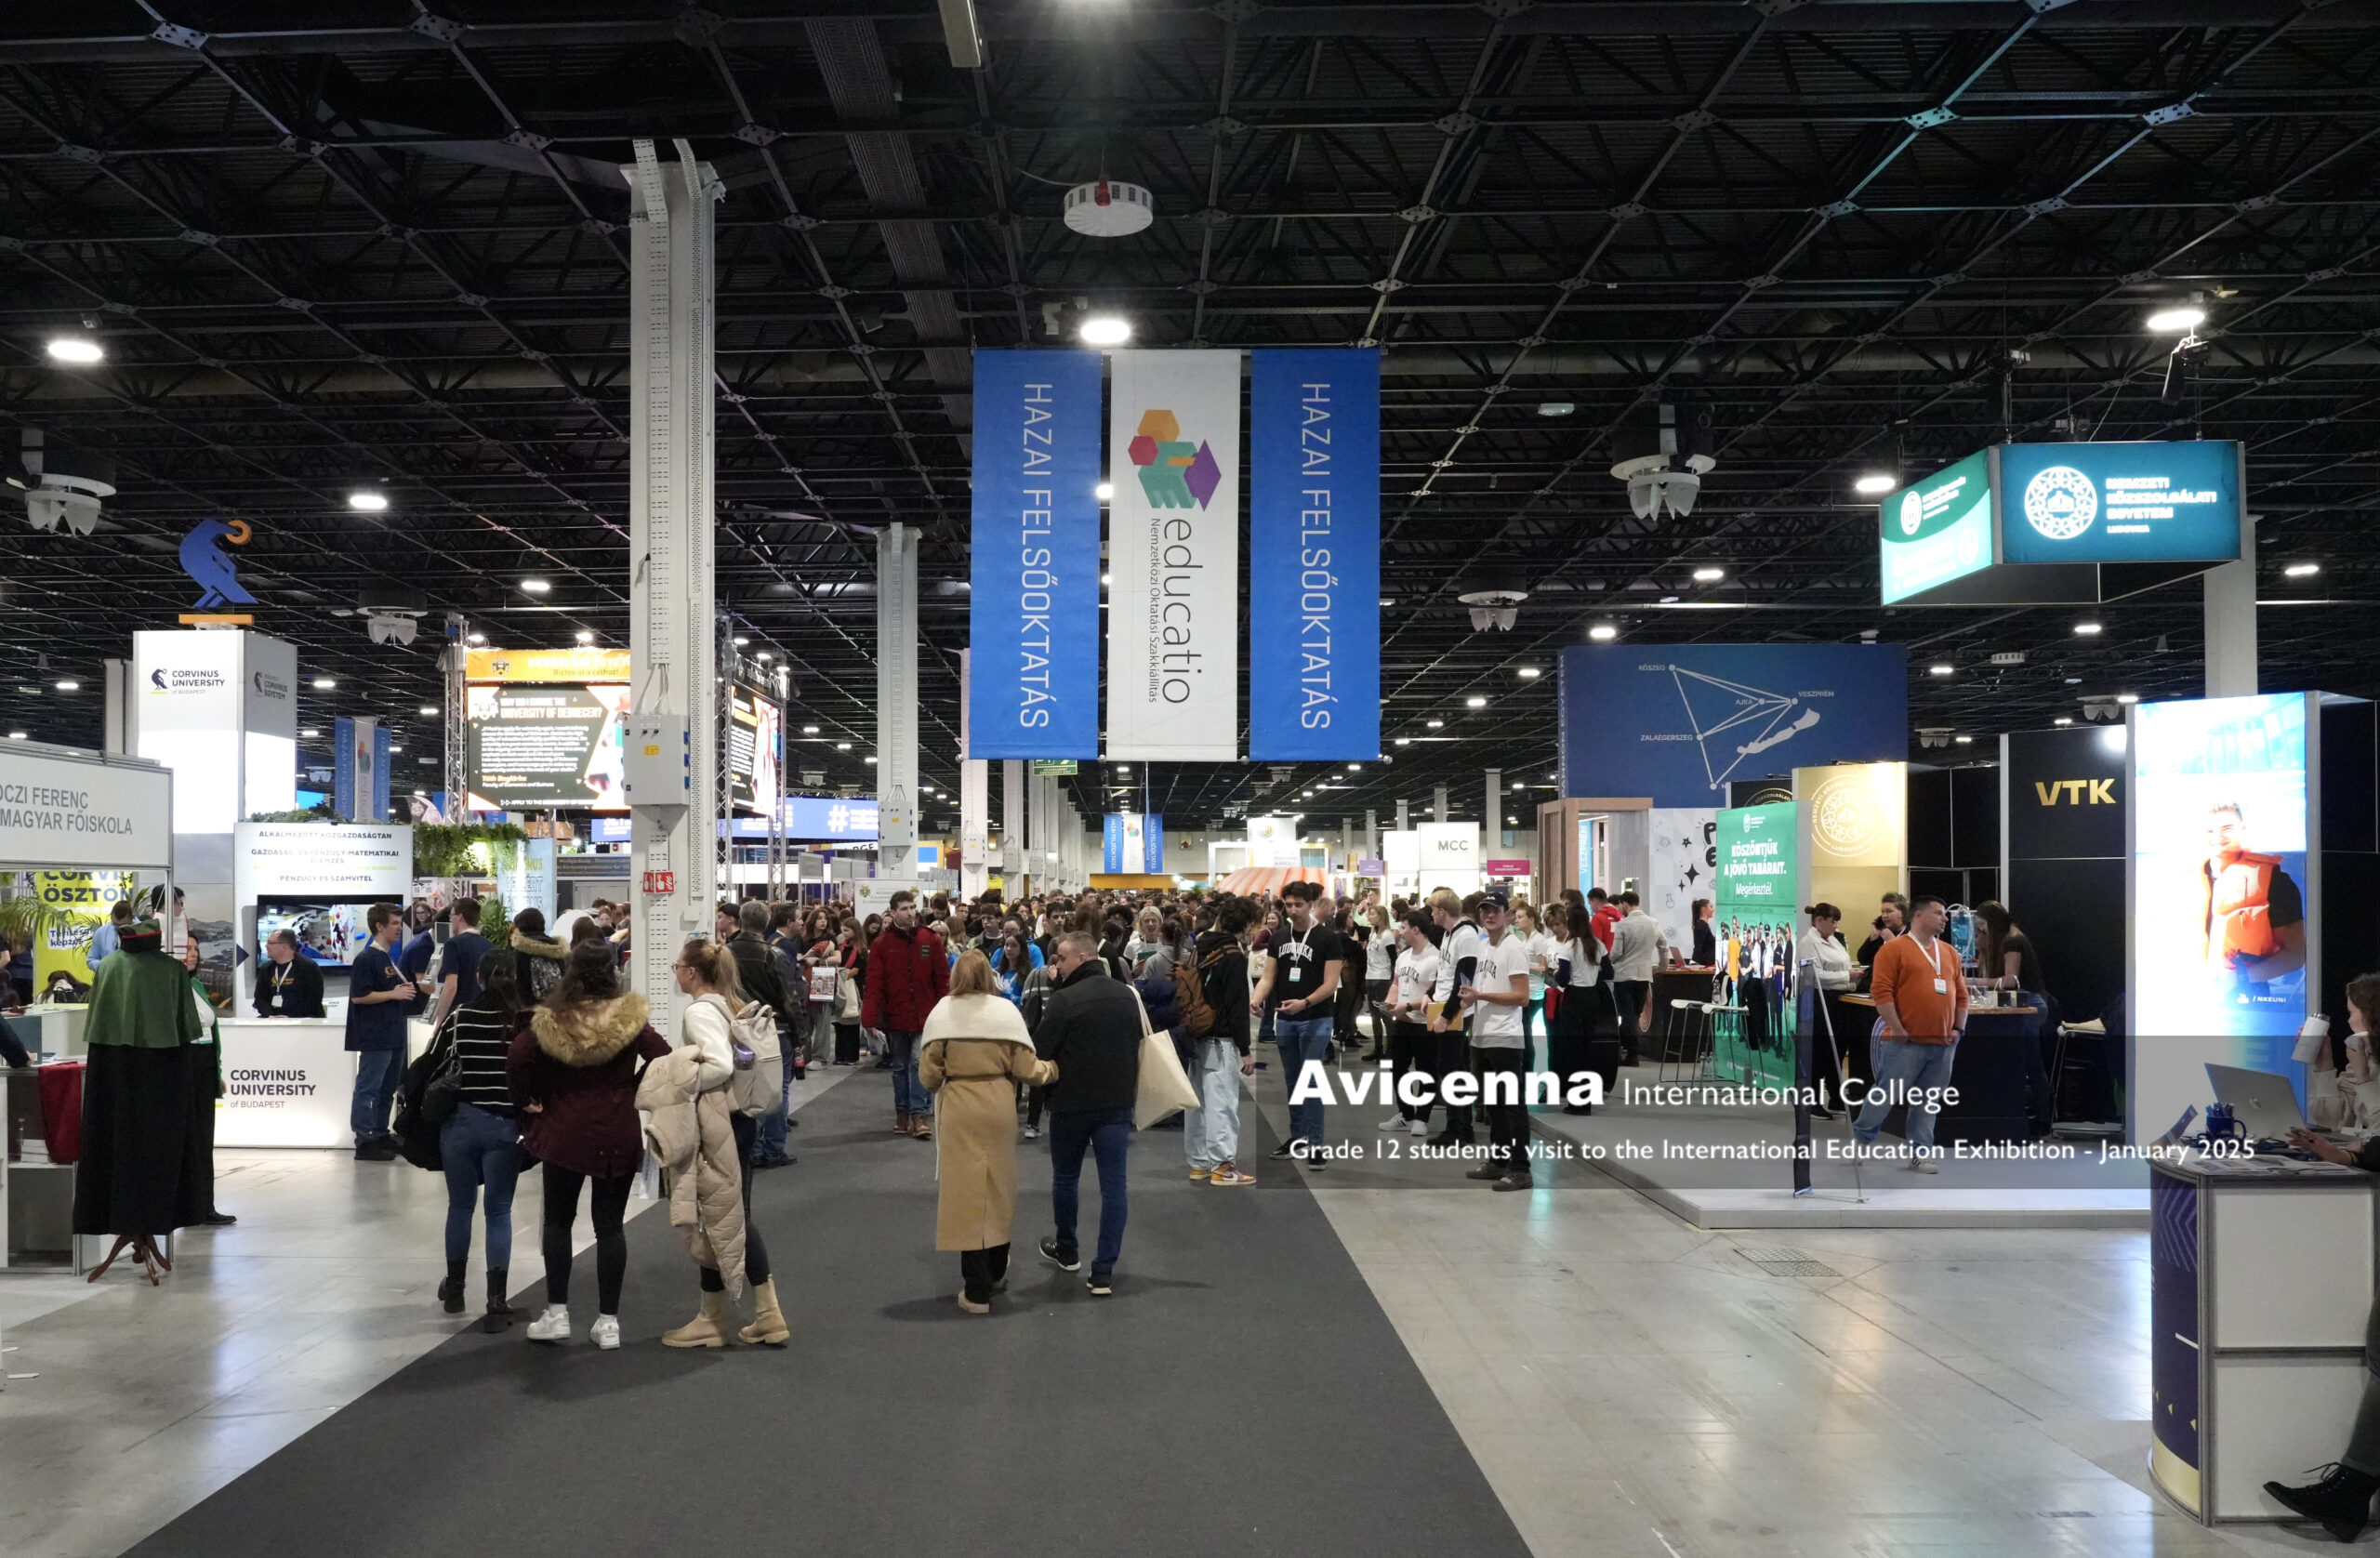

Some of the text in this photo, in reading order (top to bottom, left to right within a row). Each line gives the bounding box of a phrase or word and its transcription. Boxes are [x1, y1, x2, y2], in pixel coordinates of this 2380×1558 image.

[1024, 384, 1053, 475] HAZAI
[1301, 384, 1339, 729] HAZAI FELSŐOKTATÁS
[1020, 489, 1059, 729] FELSŐOKTATÁS
[1148, 517, 1161, 703] Nemzetközi Oktatási Szakkiállítás
[1161, 518, 1203, 704] educatio
[171, 679, 225, 687] UNIVERSITY
[33, 786, 89, 810] FERENC
[2035, 777, 2117, 806] VTK
[0, 808, 134, 836] MAGYAR FŐISKOLA
[1437, 839, 1469, 852] MCC
[1731, 838, 1778, 862] KÖSZÖNTJÜK
[1735, 882, 1774, 898] Megérkeztél.
[231, 1069, 307, 1082] CORVINUS
[231, 1084, 317, 1096] UNIVERSITY
[231, 1101, 285, 1109] of BUDAPEST
